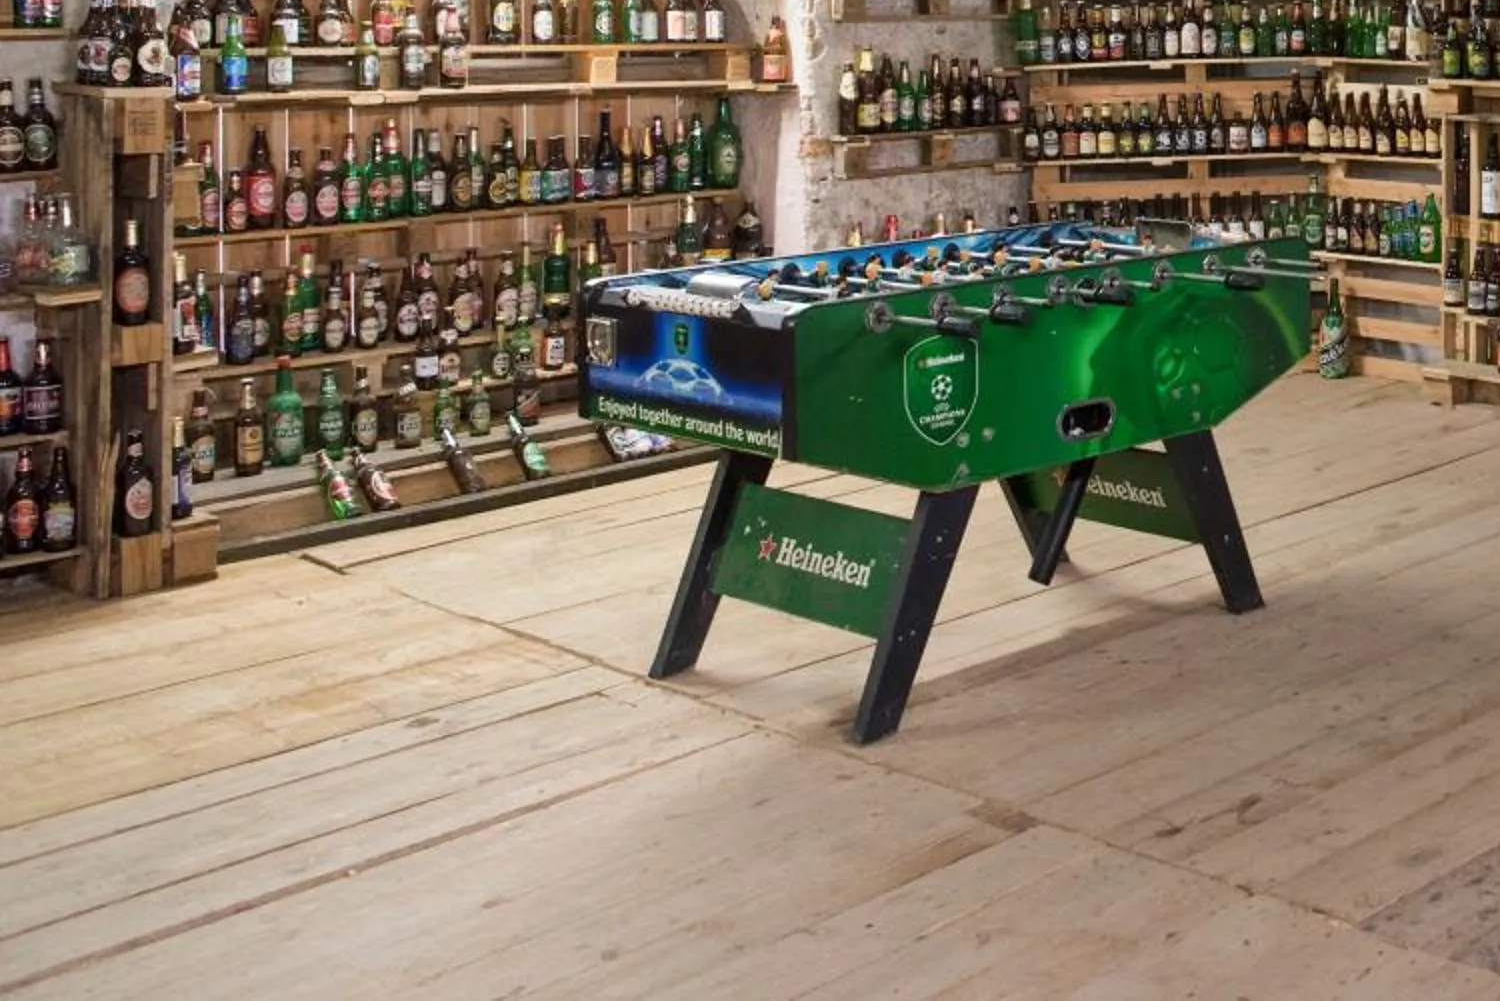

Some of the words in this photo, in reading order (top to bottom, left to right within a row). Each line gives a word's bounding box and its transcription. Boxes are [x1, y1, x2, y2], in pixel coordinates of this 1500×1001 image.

[598, 396, 637, 419] Enjoyed
[638, 404, 683, 426] together
[685, 417, 723, 437] around
[725, 422, 745, 441] the
[1086, 475, 1167, 509] eineken
[776, 536, 872, 588] Heineken
